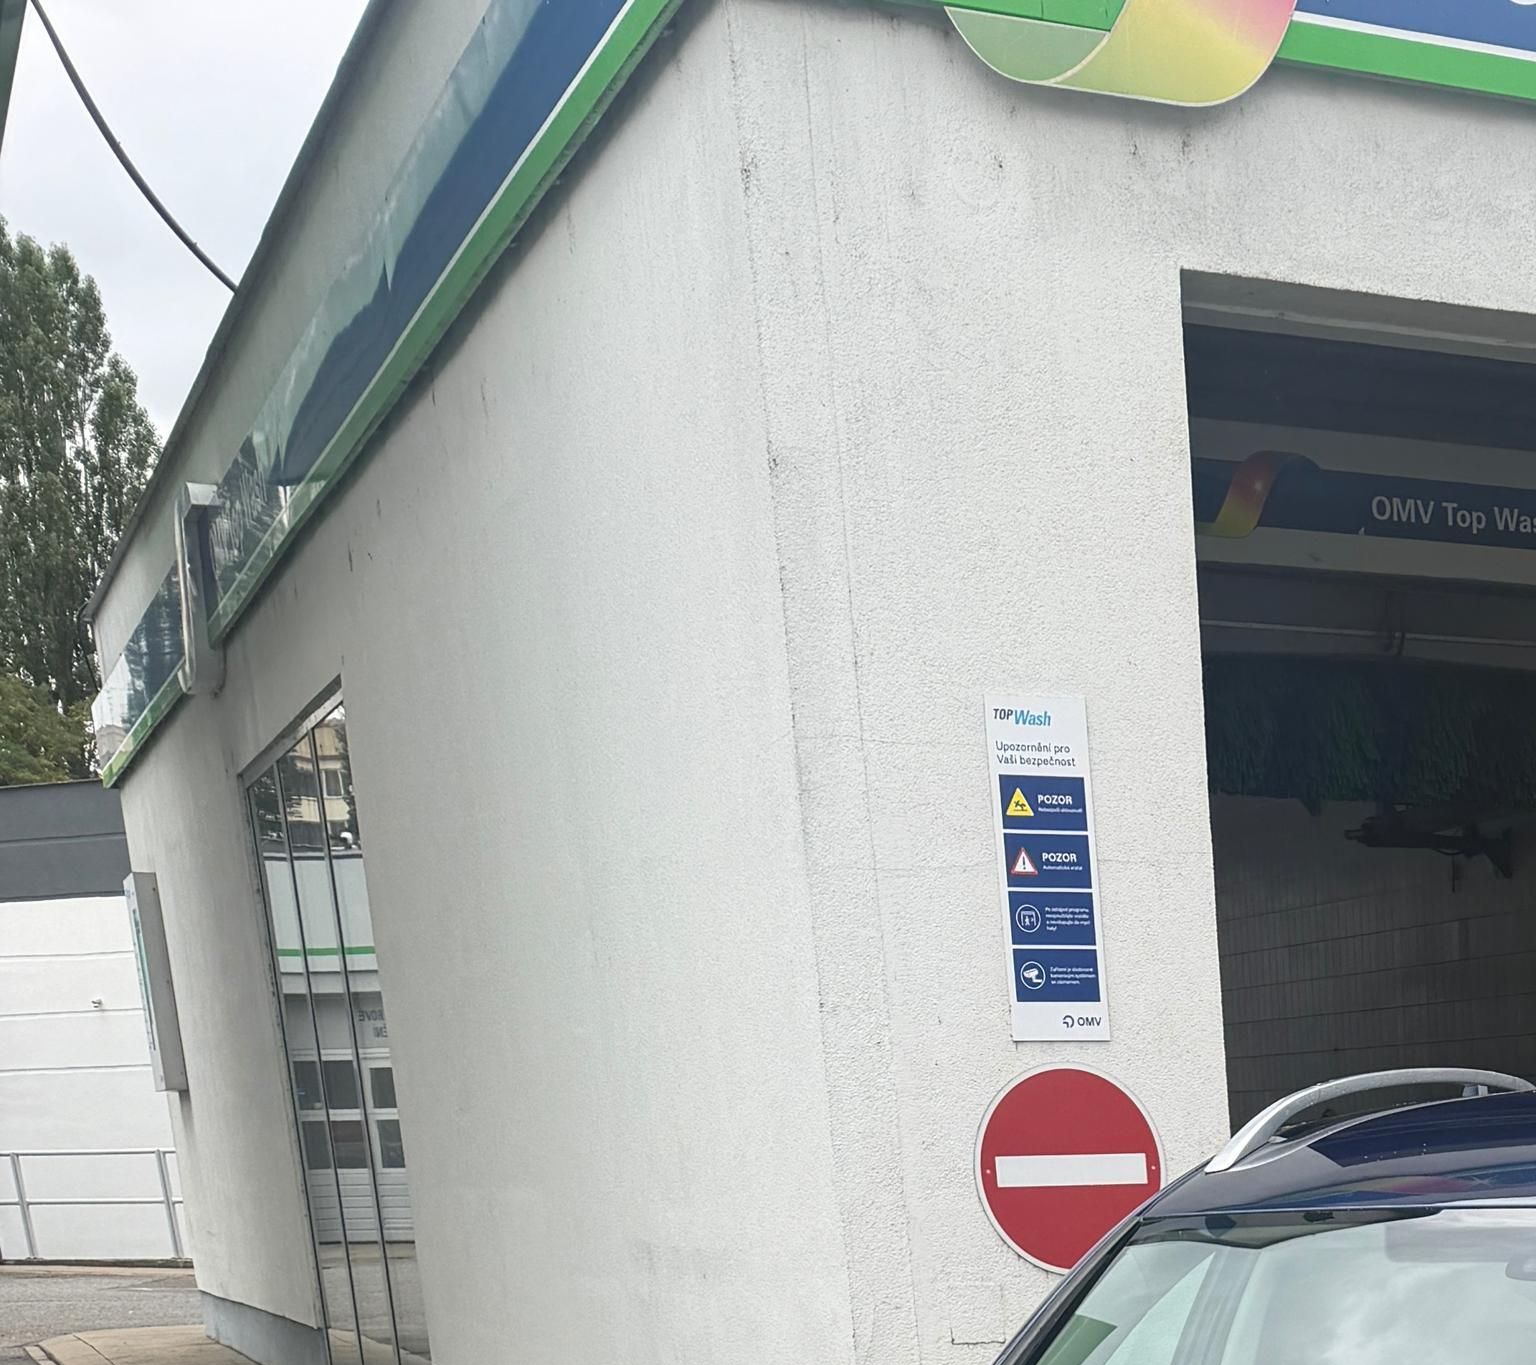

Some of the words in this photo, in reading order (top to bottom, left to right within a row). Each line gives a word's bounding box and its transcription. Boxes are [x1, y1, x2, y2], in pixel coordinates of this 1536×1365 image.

[1370, 495, 1436, 525] OMV
[1441, 502, 1487, 535] Top
[1054, 744, 1071, 755] pro
[997, 754, 1018, 765] Vaši
[1019, 755, 1076, 768] bezpečnost
[1037, 794, 1073, 805] POZOR
[1042, 852, 1077, 863] POZOR
[1077, 1016, 1102, 1028] OMV
